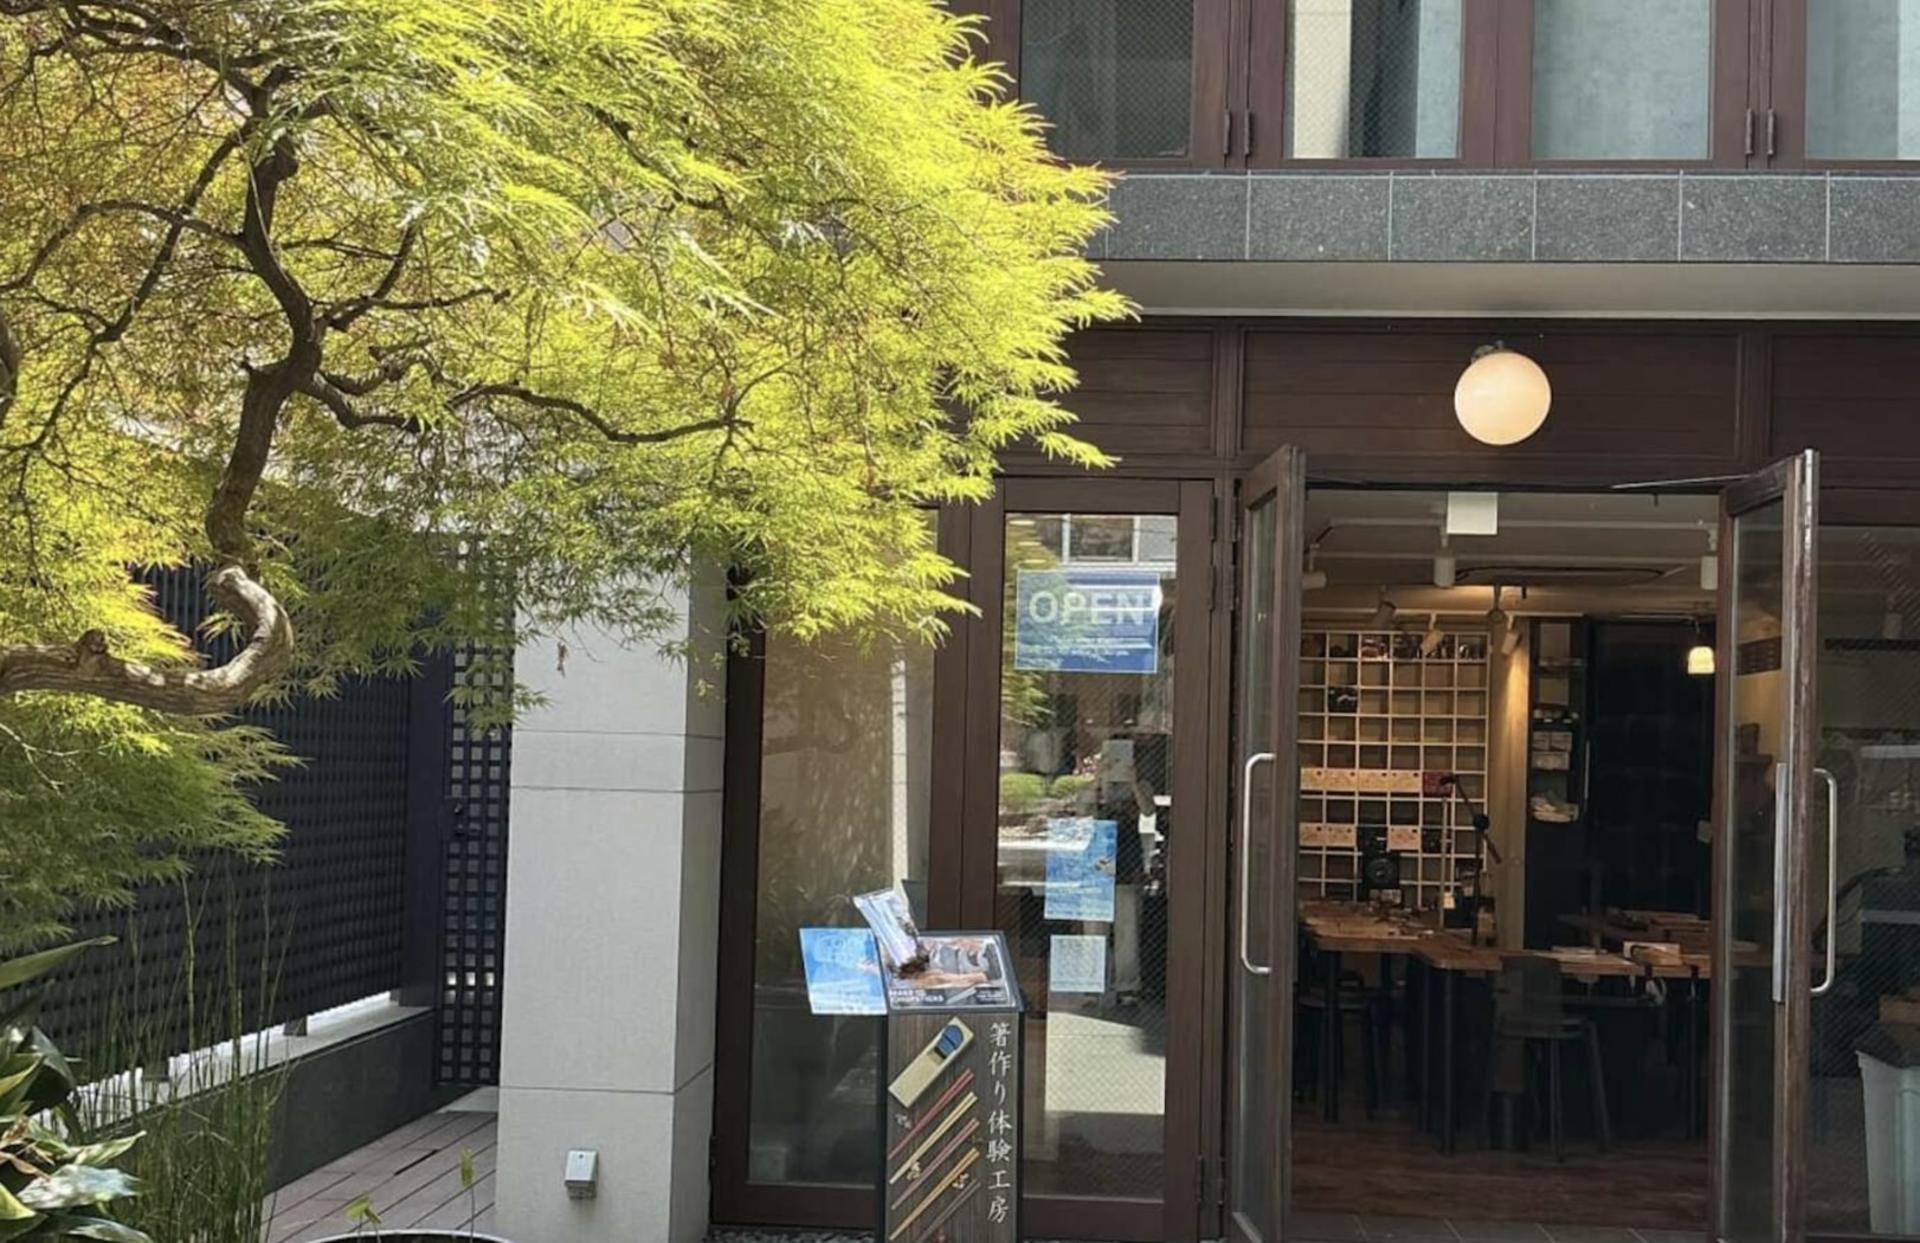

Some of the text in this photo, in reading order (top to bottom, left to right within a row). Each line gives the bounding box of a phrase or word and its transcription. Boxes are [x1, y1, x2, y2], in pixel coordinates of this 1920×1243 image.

[1029, 591, 1146, 625] OPEN
[986, 1021, 1013, 1223] 箸作り体験工房
